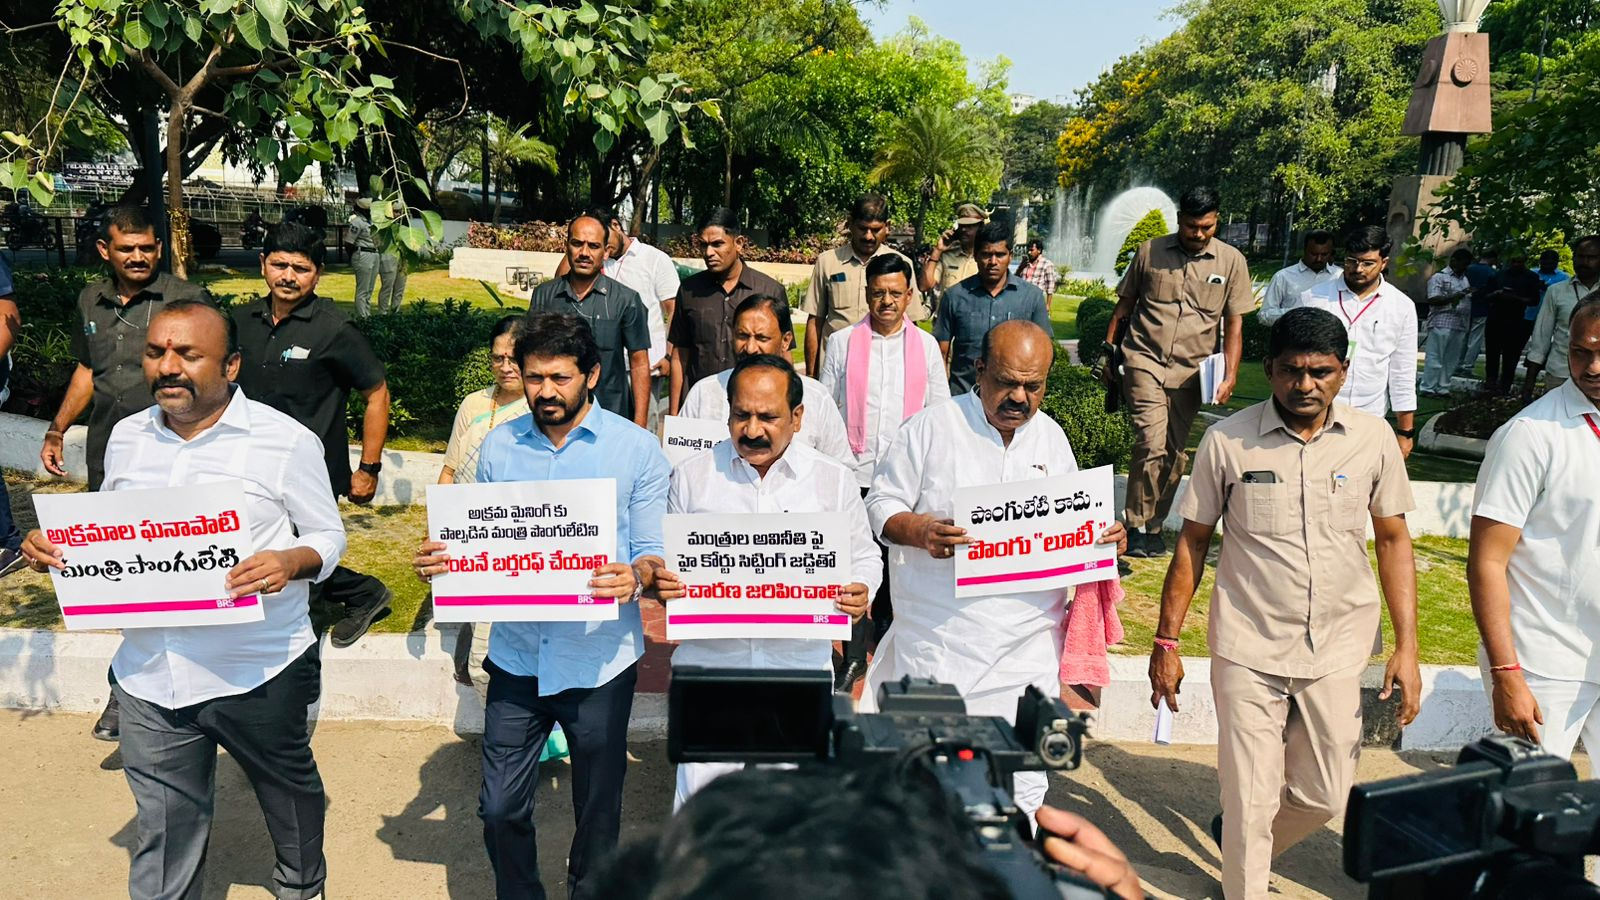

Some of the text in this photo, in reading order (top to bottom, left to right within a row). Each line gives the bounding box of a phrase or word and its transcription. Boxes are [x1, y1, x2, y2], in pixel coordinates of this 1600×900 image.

[469, 504, 567, 522] అక్రమ మైనింగ్ కు
[971, 496, 1049, 524] పొంగులేటి
[1054, 491, 1090, 514] కాదు
[46, 510, 239, 546] అక్రమాల ఘనాపాటి
[440, 522, 598, 543] పాల్పడిన మంత్రి పొంగులేటిని
[688, 530, 824, 549] మంత్రుల అవినీతి పై
[968, 537, 1031, 560] పొంగు
[61, 545, 239, 581] మంత్రి పొంగులేటి
[447, 551, 488, 572] ంటనే
[493, 551, 544, 576] బర్తరఫ్
[677, 551, 836, 574] హై కోర్టు సిట్టింగ్ జడ్జితో
[577, 596, 595, 604] BRS
[683, 582, 741, 598] చారణ
[216, 598, 235, 608] BRS
[813, 615, 829, 623] BRS
